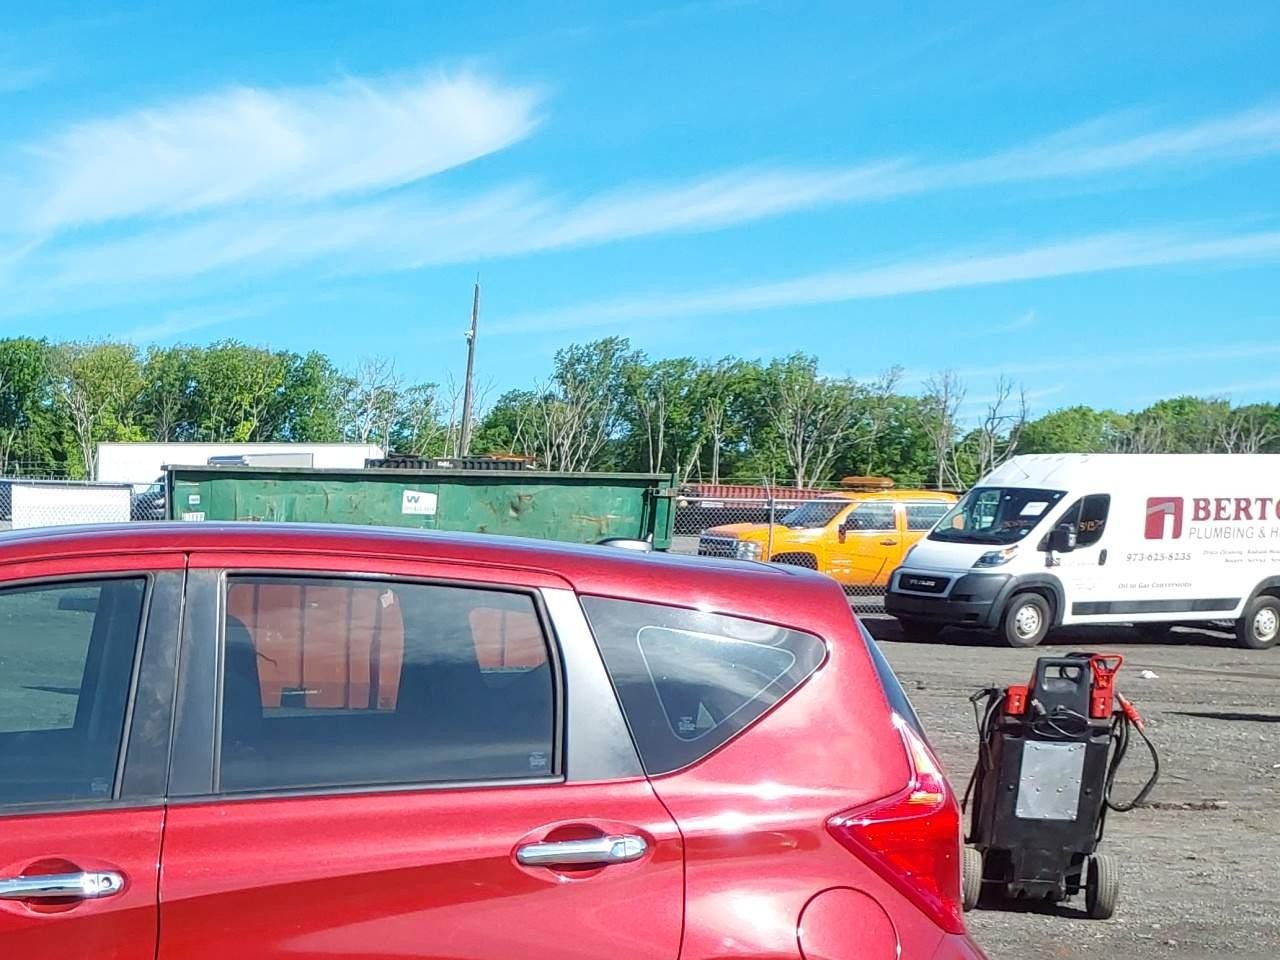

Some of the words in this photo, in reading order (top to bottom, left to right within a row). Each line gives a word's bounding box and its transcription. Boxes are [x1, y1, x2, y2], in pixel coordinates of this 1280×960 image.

[1191, 497, 1280, 521] BERT
[1188, 526, 1254, 540] PLUMBING
[1258, 526, 1266, 538] &
